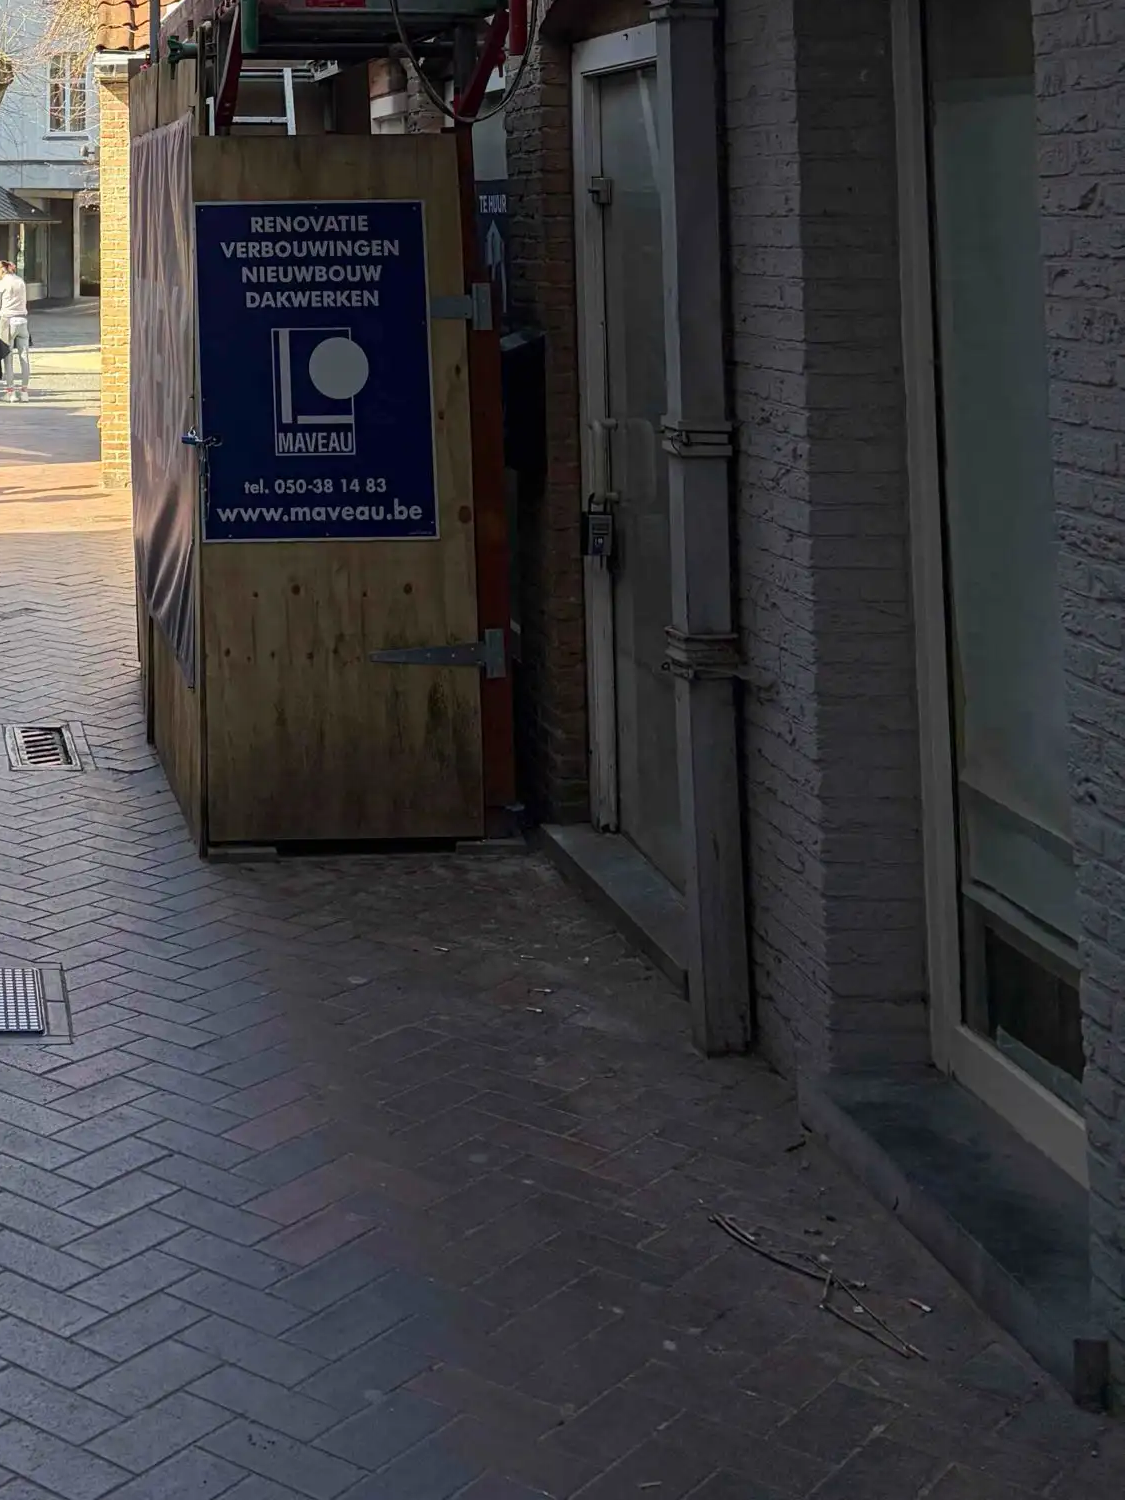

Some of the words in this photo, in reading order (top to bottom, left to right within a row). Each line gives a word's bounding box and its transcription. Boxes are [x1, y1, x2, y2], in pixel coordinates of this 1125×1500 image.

[479, 194, 488, 213] TE
[488, 194, 507, 213] HUUR
[250, 215, 369, 233] RENOVATIE
[220, 239, 400, 258] VERBOUWINGEN
[241, 264, 383, 283] NIEUWBOUW
[245, 290, 380, 308] DAKWERKEN
[278, 431, 353, 453] MAVEAU
[244, 478, 269, 494] tel.
[274, 478, 334, 494] 050-38
[341, 478, 360, 493] 14
[366, 478, 387, 493] 83
[216, 498, 423, 522] www.maveau.be
